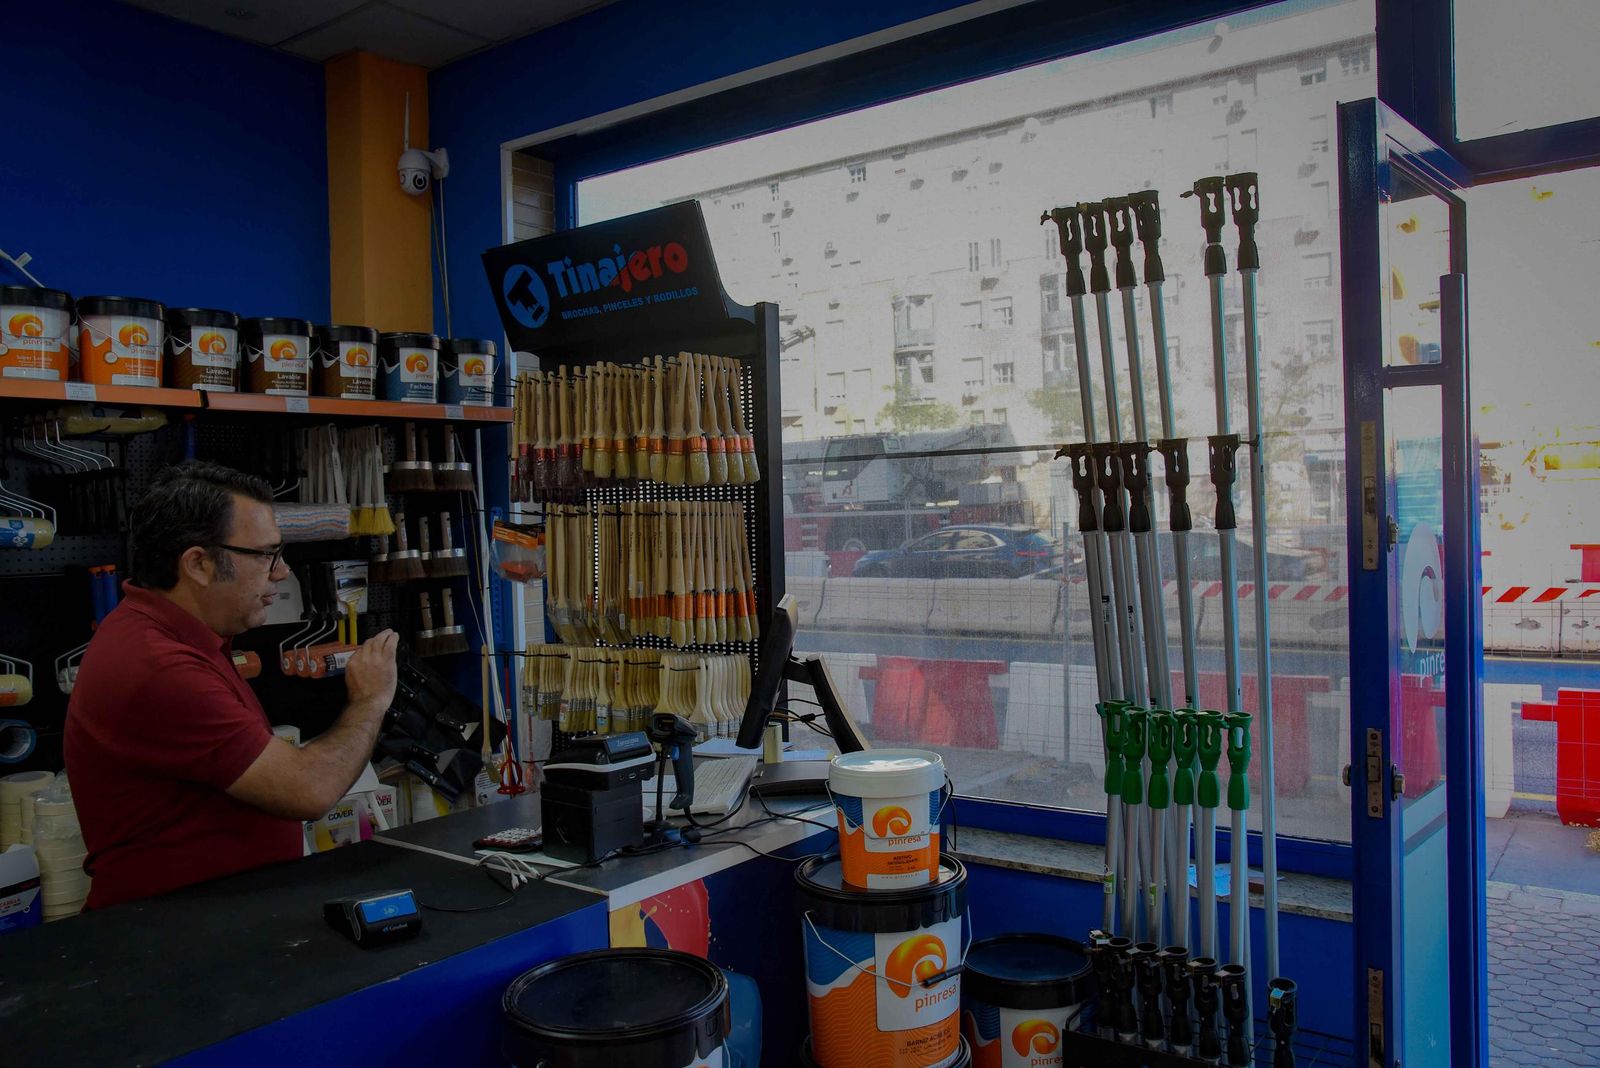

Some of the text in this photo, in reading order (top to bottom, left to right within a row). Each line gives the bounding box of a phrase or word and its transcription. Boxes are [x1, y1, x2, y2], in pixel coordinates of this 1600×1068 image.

[547, 241, 689, 299] Tinajero
[561, 306, 603, 321] BROCHAS,
[603, 297, 645, 314] PINCELES
[652, 286, 699, 304] RODILLOS
[327, 809, 353, 821] COVER
[888, 835, 922, 847] pinresa
[915, 984, 957, 1012] pinresa
[1031, 1056, 1064, 1067] pinres
